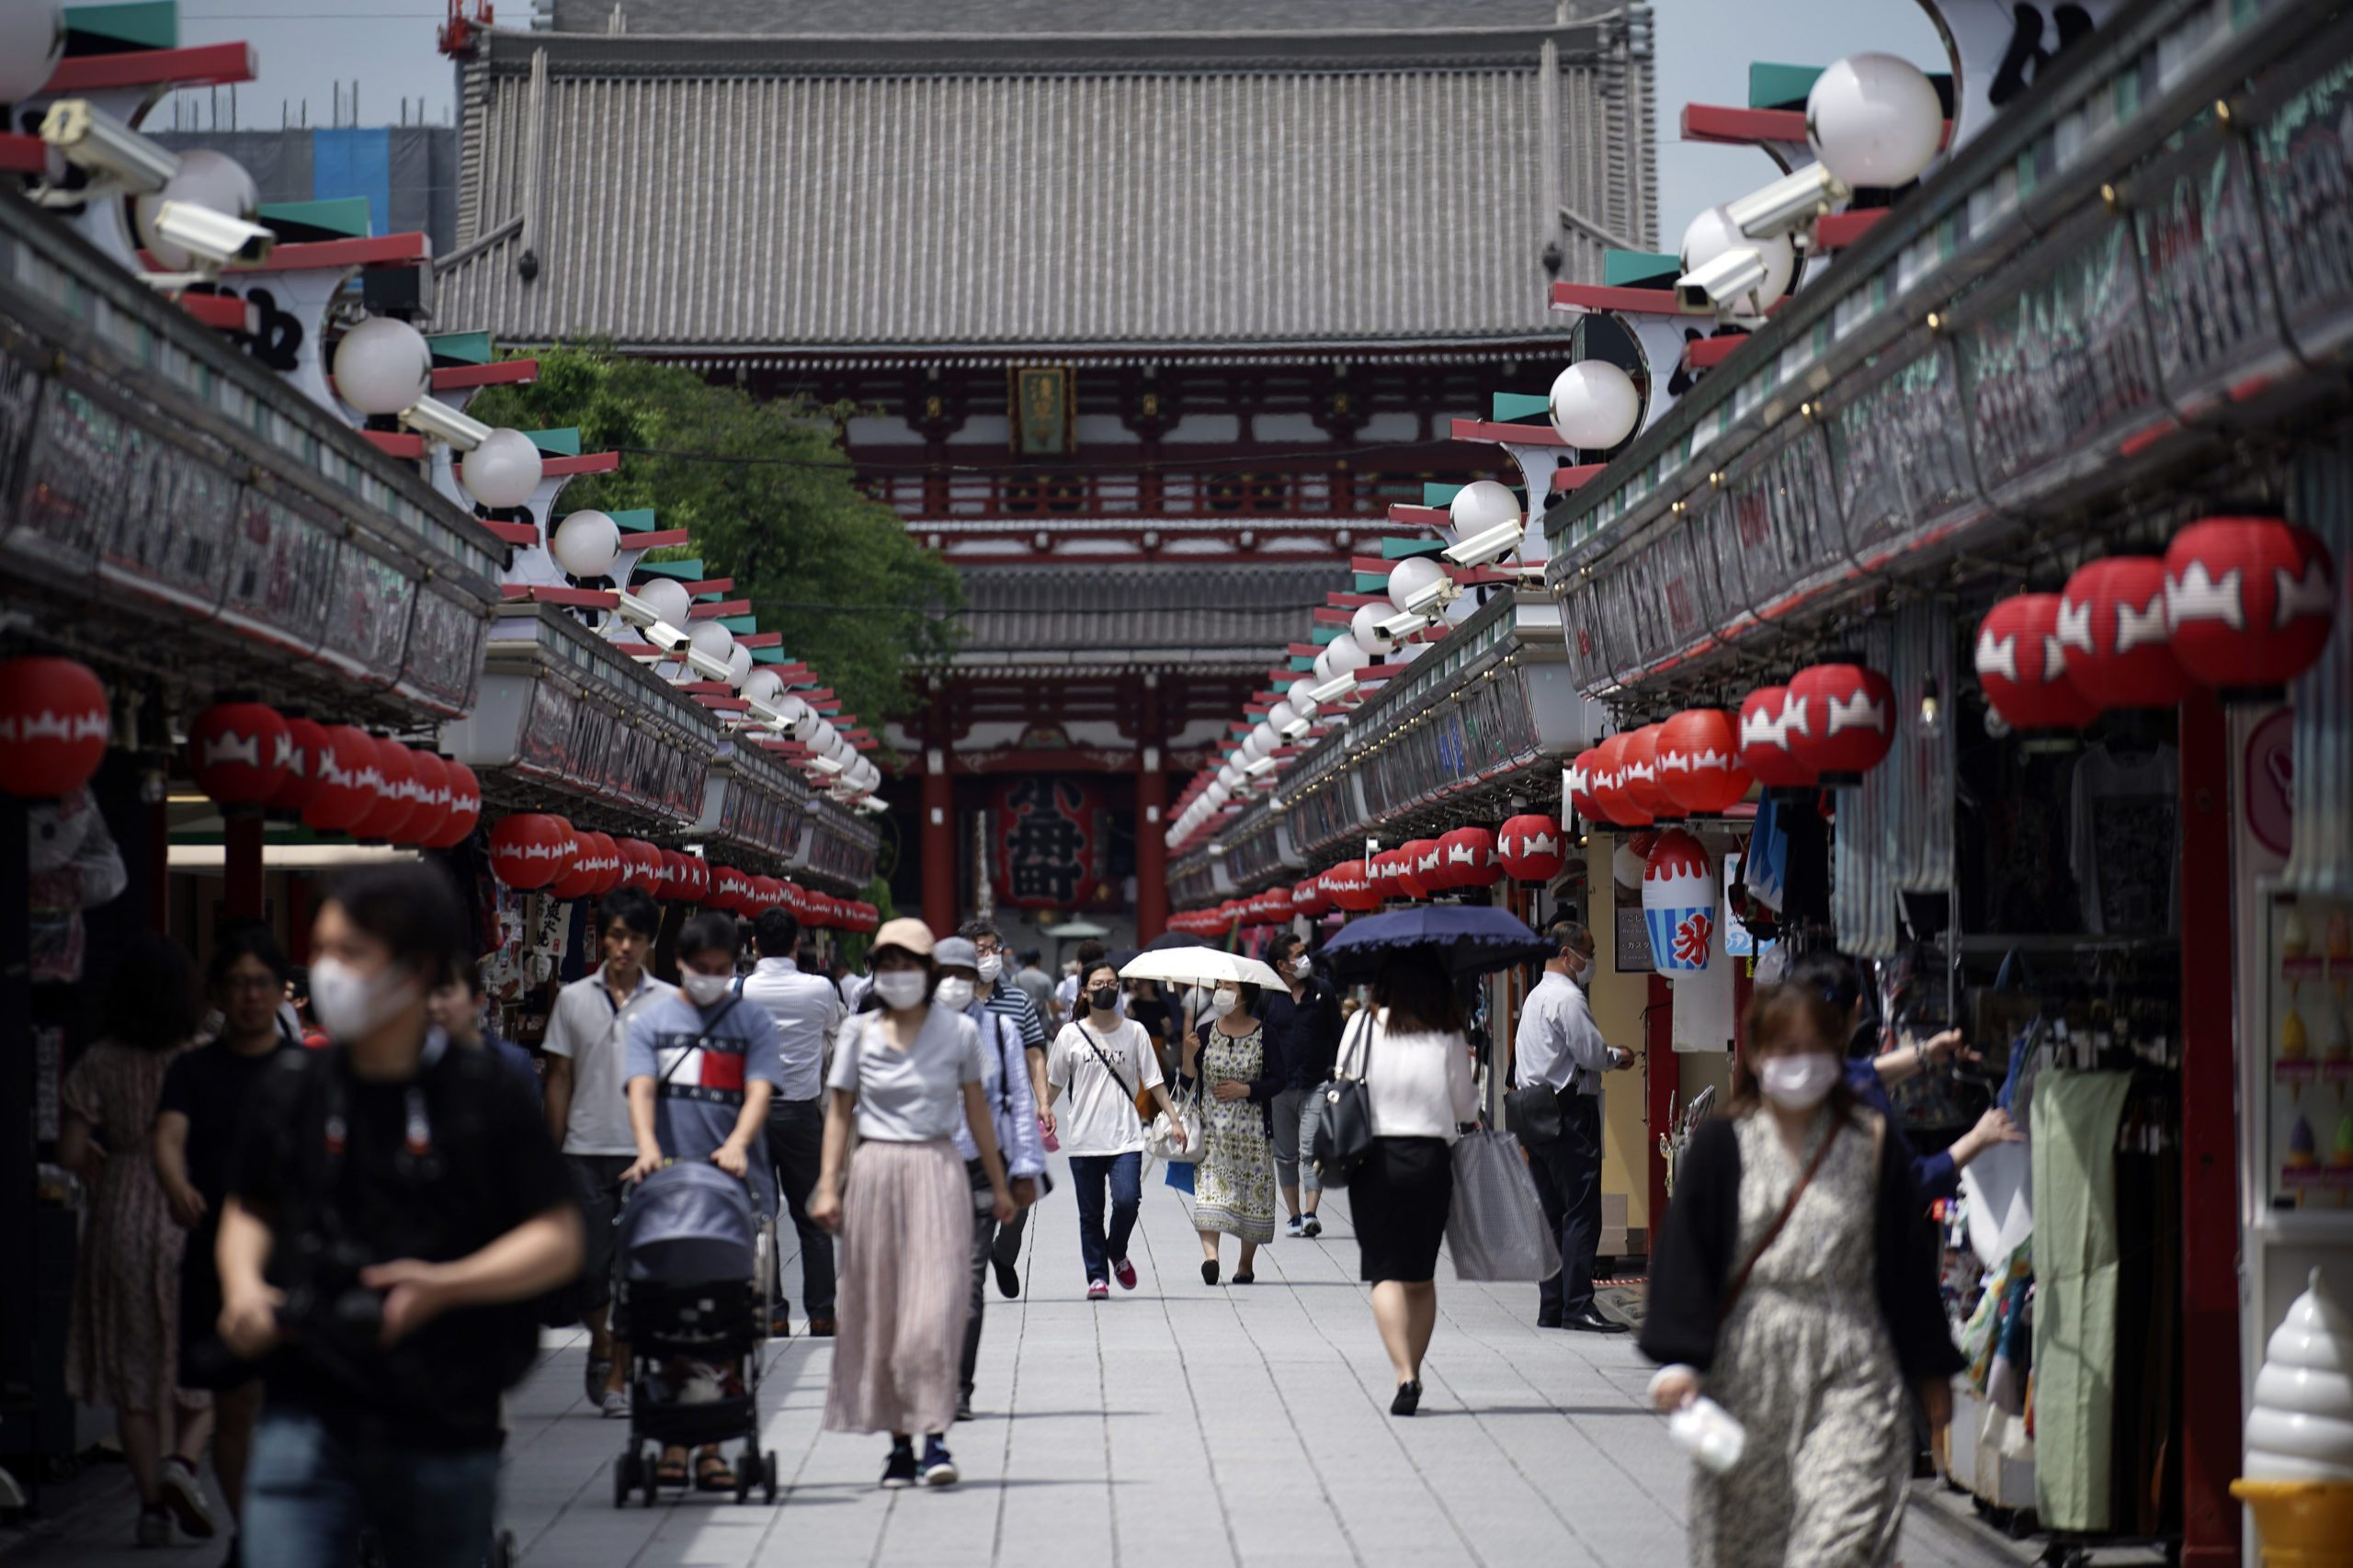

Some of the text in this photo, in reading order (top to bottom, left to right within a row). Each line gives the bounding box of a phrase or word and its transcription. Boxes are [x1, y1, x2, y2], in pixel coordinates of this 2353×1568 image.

[1006, 778, 1086, 903] 小舟町
[1674, 914, 1712, 966] 氷
